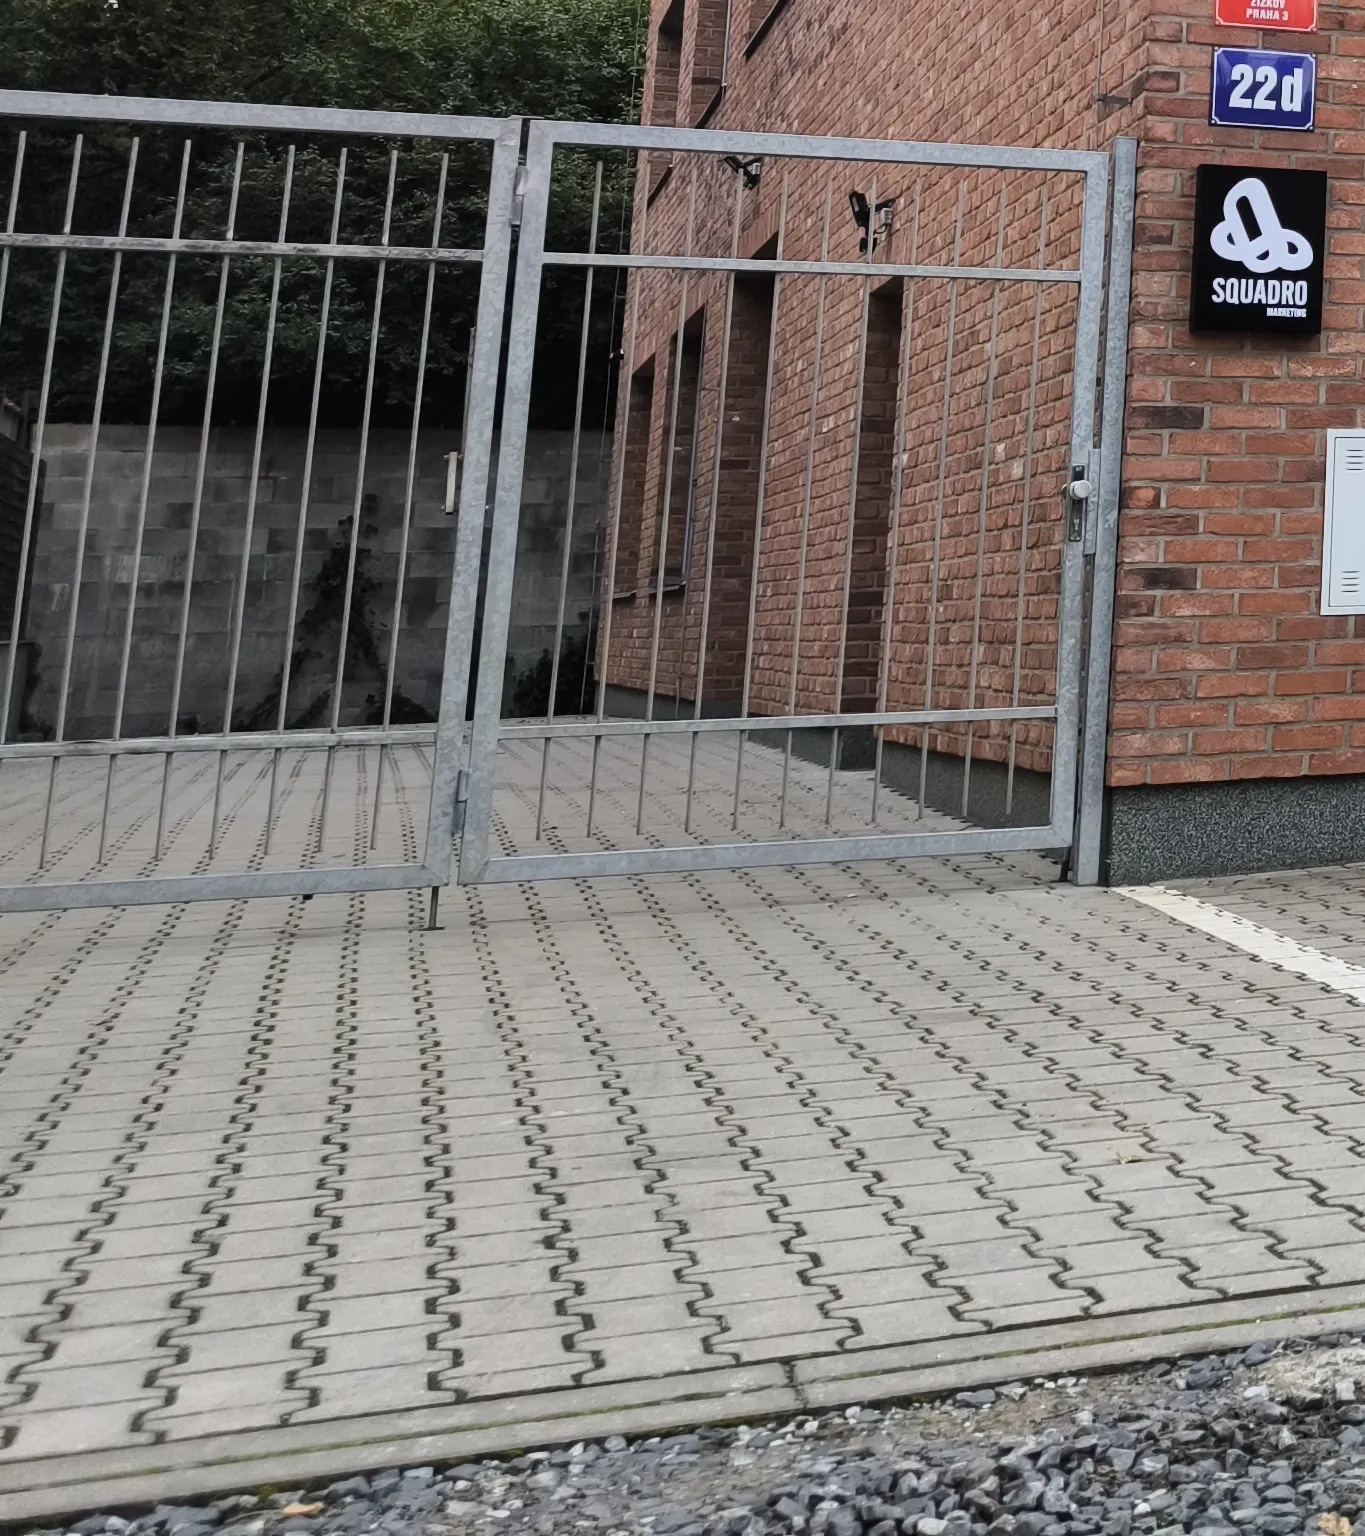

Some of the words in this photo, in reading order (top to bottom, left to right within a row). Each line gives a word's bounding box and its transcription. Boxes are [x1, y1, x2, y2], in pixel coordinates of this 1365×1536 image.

[1245, 8, 1280, 20] PRAHA
[1281, 10, 1289, 21] 3
[1228, 64, 1303, 113] 22d
[1211, 277, 1308, 306] SQUADRO
